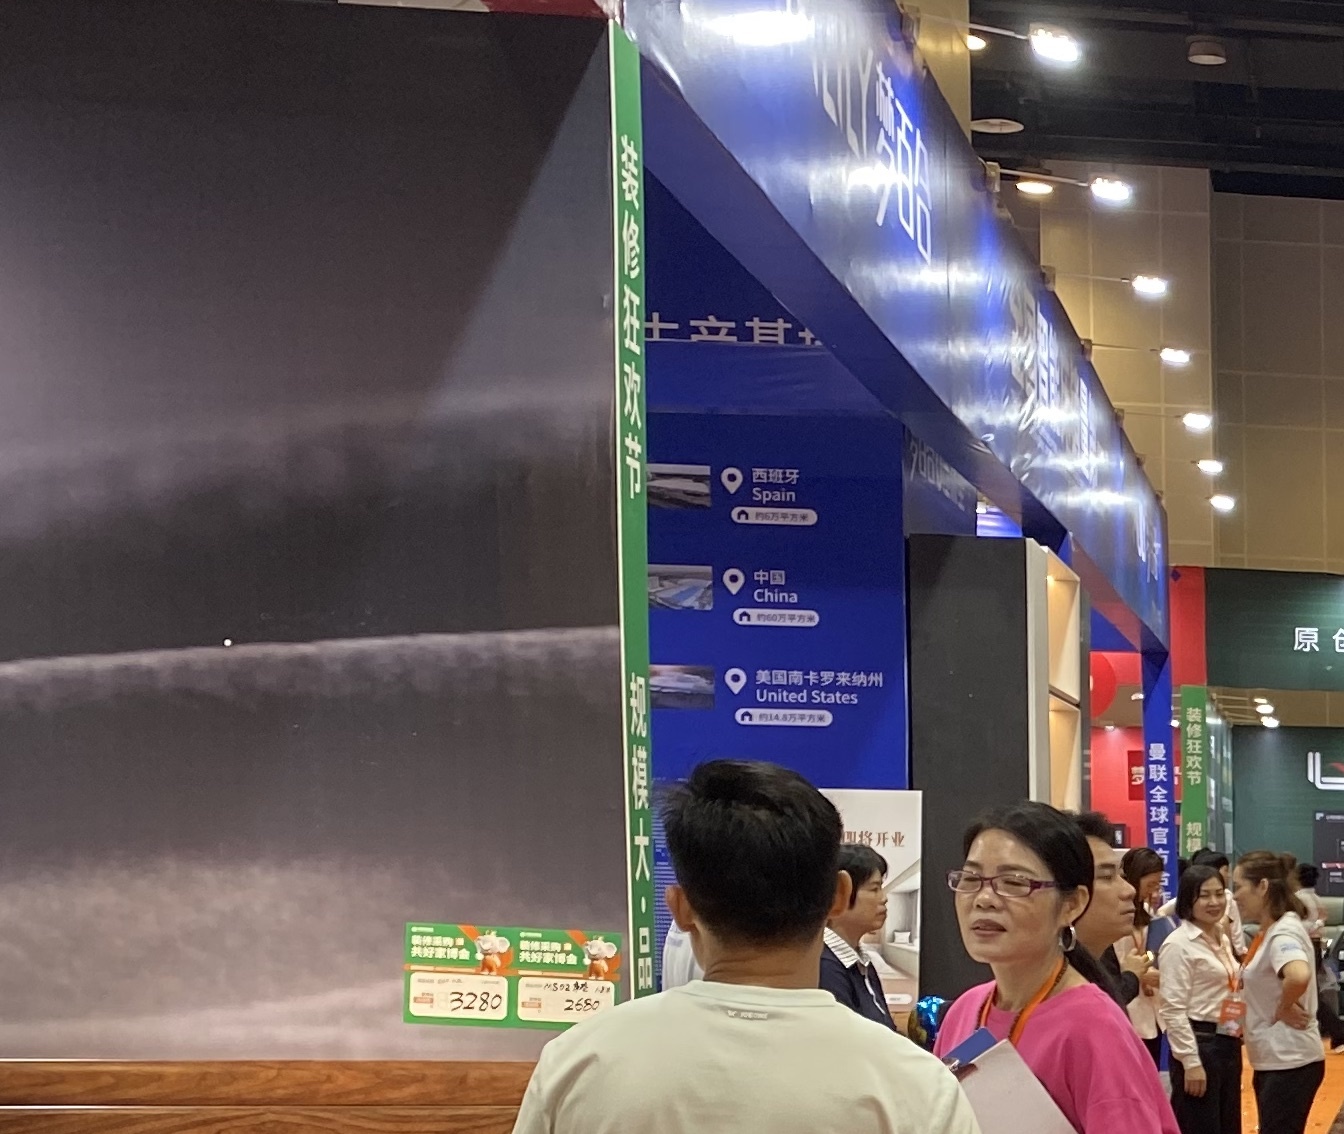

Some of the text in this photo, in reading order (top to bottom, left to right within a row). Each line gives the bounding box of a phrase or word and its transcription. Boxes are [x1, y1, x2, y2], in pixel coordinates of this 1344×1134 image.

[621, 135, 642, 500] 装修狂欢节
[752, 468, 800, 485] 西班牙
[752, 488, 796, 503] Spain
[753, 569, 786, 586] 中国
[753, 589, 798, 604] China
[755, 670, 884, 688] 美国南卡罗来纳州
[756, 689, 859, 706] United States
[1186, 707, 1203, 786] 装修狂欢节
[450, 991, 503, 1012] 3280
[564, 997, 600, 1011] 2680
